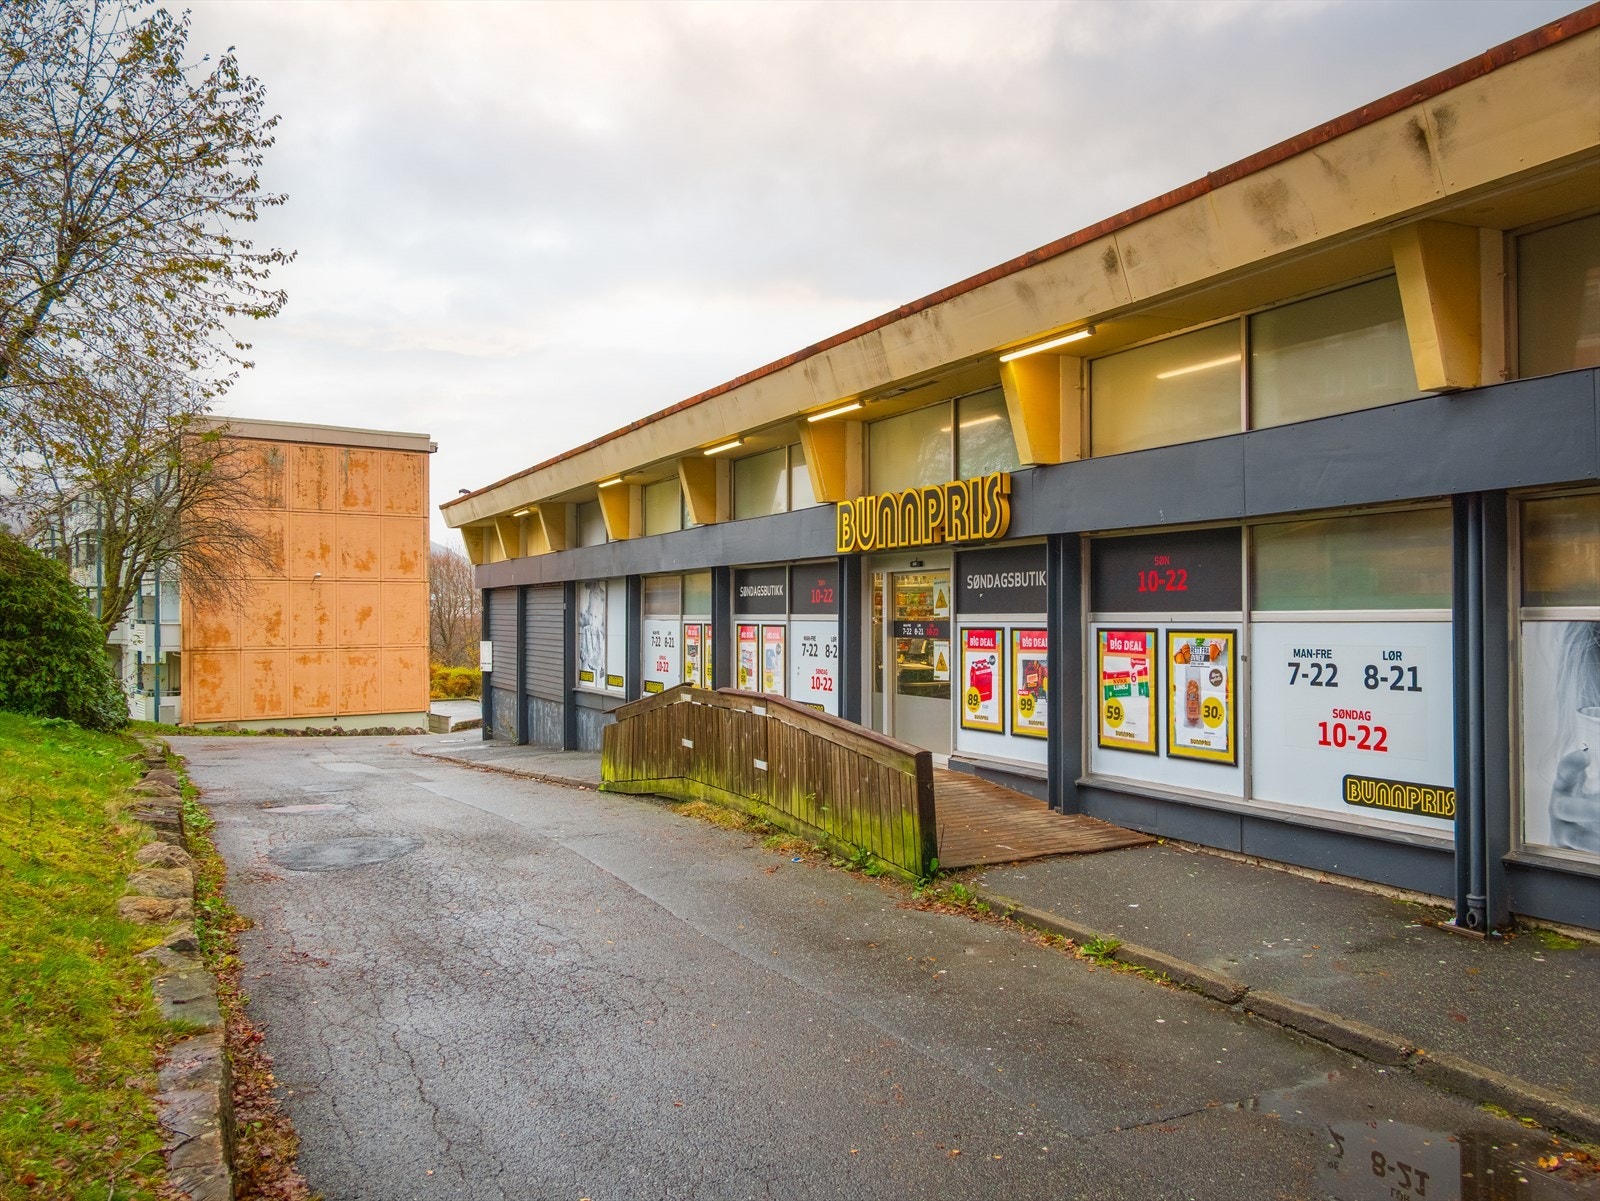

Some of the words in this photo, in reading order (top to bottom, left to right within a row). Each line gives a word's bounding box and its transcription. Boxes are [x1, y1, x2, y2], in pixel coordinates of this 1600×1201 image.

[837, 471, 1010, 552] BUNNPRIS
[1154, 555, 1170, 566] SØN
[1138, 569, 1188, 592] 10-22
[740, 584, 783, 597] SØNDAGSBUTIKK
[811, 589, 833, 603] 10-22
[652, 636, 661, 647] 7-22
[980, 638, 994, 647] DEAL
[1123, 640, 1143, 652] DEAL
[802, 643, 818, 657] 7-22
[1293, 649, 1332, 659] MAN-FRE
[1382, 650, 1403, 661] LØR
[657, 662, 669, 672] 10-22
[815, 668, 828, 676] SØNDAG
[1131, 672, 1137, 683] 6
[1287, 662, 1339, 687] 7-22
[1364, 664, 1423, 692] 8-21
[811, 676, 833, 692] 10-22
[1332, 708, 1371, 721] SØNDAG
[1318, 722, 1388, 752] 10-22
[1346, 778, 1455, 816] BUNNPRIS
